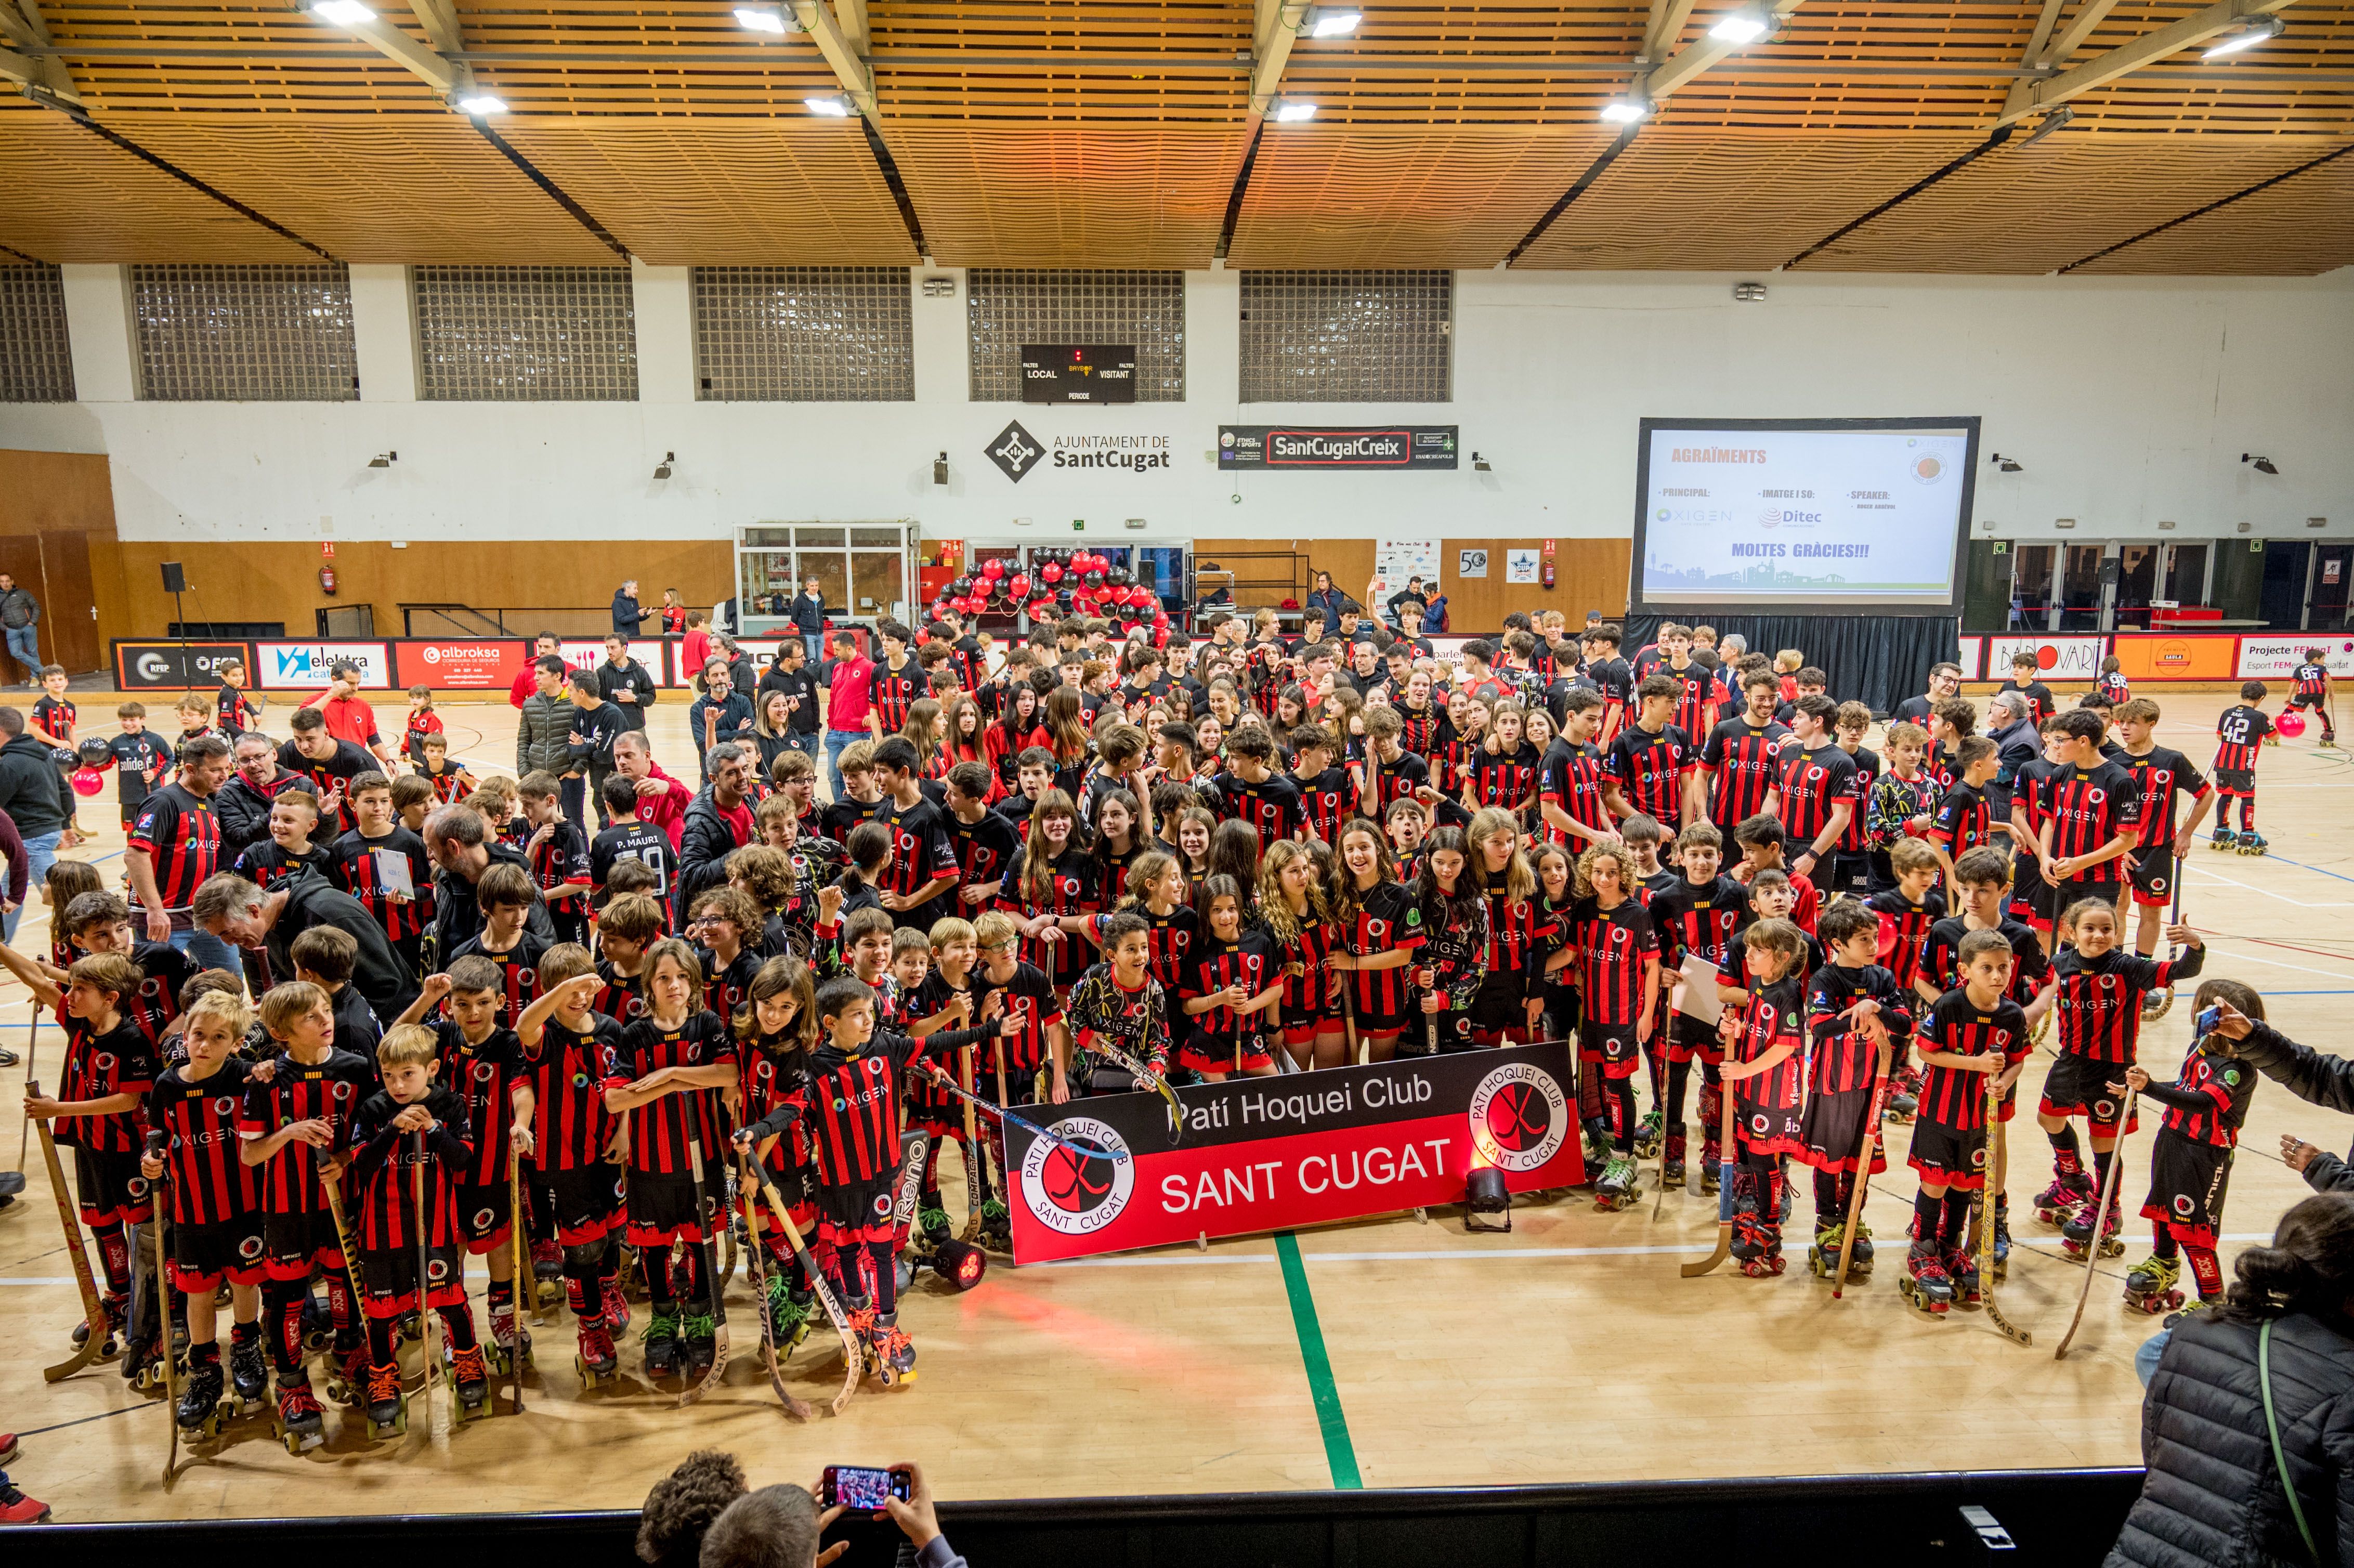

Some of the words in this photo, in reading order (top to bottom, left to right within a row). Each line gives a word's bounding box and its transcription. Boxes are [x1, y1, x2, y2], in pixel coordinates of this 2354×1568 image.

[1054, 436, 1148, 448] AJUNTAMENT
[1153, 436, 1170, 448] DE
[1275, 437, 1400, 460] SantCugatCreix
[1053, 450, 1170, 473] SantCugat
[1671, 447, 1767, 464] AGRAÏMENTS
[1663, 488, 1710, 497] PRINCIPAL:
[1762, 489, 1795, 499] IMATGE
[1802, 490, 1815, 499] SO:
[1851, 491, 1890, 500] SPEAKER:
[1656, 507, 1732, 522] OXIGEN
[1783, 511, 1822, 522] Ditec
[1732, 543, 1786, 557] MOLTES
[1793, 541, 1870, 558] GRÀCIES!!!
[442, 646, 500, 658] albroksa
[2249, 646, 2291, 656] Projecte
[2294, 646, 2332, 654] FEnI
[2247, 661, 2271, 670] Esport
[313, 669, 369, 678] cata
[2300, 668, 2319, 681] 85
[883, 696, 912, 704] OXIGEN
[2222, 716, 2250, 744] 42
[1642, 768, 1679, 783] OXIGE
[1575, 781, 1599, 794] OXIG
[1780, 781, 1819, 799] OXIGEN
[2136, 792, 2167, 801] IGEN
[1314, 815, 1339, 827] GEN
[2056, 805, 2100, 823] OXIGEN
[617, 841, 625, 849] P.
[627, 835, 659, 847] MAURI
[1965, 830, 1991, 841] OXIG
[185, 837, 220, 851] OXIGE
[1026, 904, 1078, 917] OXIGEN
[1487, 930, 1529, 942] XIGEN
[1348, 941, 1386, 955] IGEN
[1425, 938, 1467, 958] XIGEN
[1583, 947, 1624, 961] OXIGEN
[1675, 942, 1726, 957] OXIGE
[1152, 953, 1182, 965] XIGE
[1212, 981, 1258, 993] OXEN
[2061, 998, 2120, 1009] OXIGEN
[2149, 996, 2173, 1023] AZEMAD
[128, 1004, 168, 1026] GEN
[1103, 1018, 1141, 1037] XIGEN
[1748, 1023, 1771, 1040] GEN
[2033, 1021, 2050, 1046] ZEMAD
[832, 1083, 890, 1112] OXIGEN
[1472, 1090, 1487, 1120] PATI
[1487, 1067, 1536, 1092] HOQUEI
[1538, 1068, 1562, 1109] CLUB
[1167, 1097, 1229, 1134] Patí
[1243, 1082, 1351, 1126] Hoquei
[1362, 1074, 1432, 1108] Club
[171, 1125, 240, 1149] OXIGEN
[1482, 1140, 1514, 1168] SANT
[1522, 1133, 1561, 1169] CUGAT
[968, 1155, 981, 1207] COMPACT
[1161, 1160, 1282, 1214] SANT
[1298, 1138, 1450, 1195] CUGAT
[893, 1140, 927, 1234] Reno
[1035, 1200, 1073, 1231] SANT
[1080, 1193, 1124, 1231] CUGAT
[2197, 1257, 2215, 1278] PHCSC
[1982, 1288, 2015, 1336] AZEMAD
[585, 1318, 604, 1328] SIOUX
[236, 1343, 258, 1354] SIOUX
[699, 1343, 727, 1395] AZEMAD
[847, 1340, 860, 1396] AZEMAD
